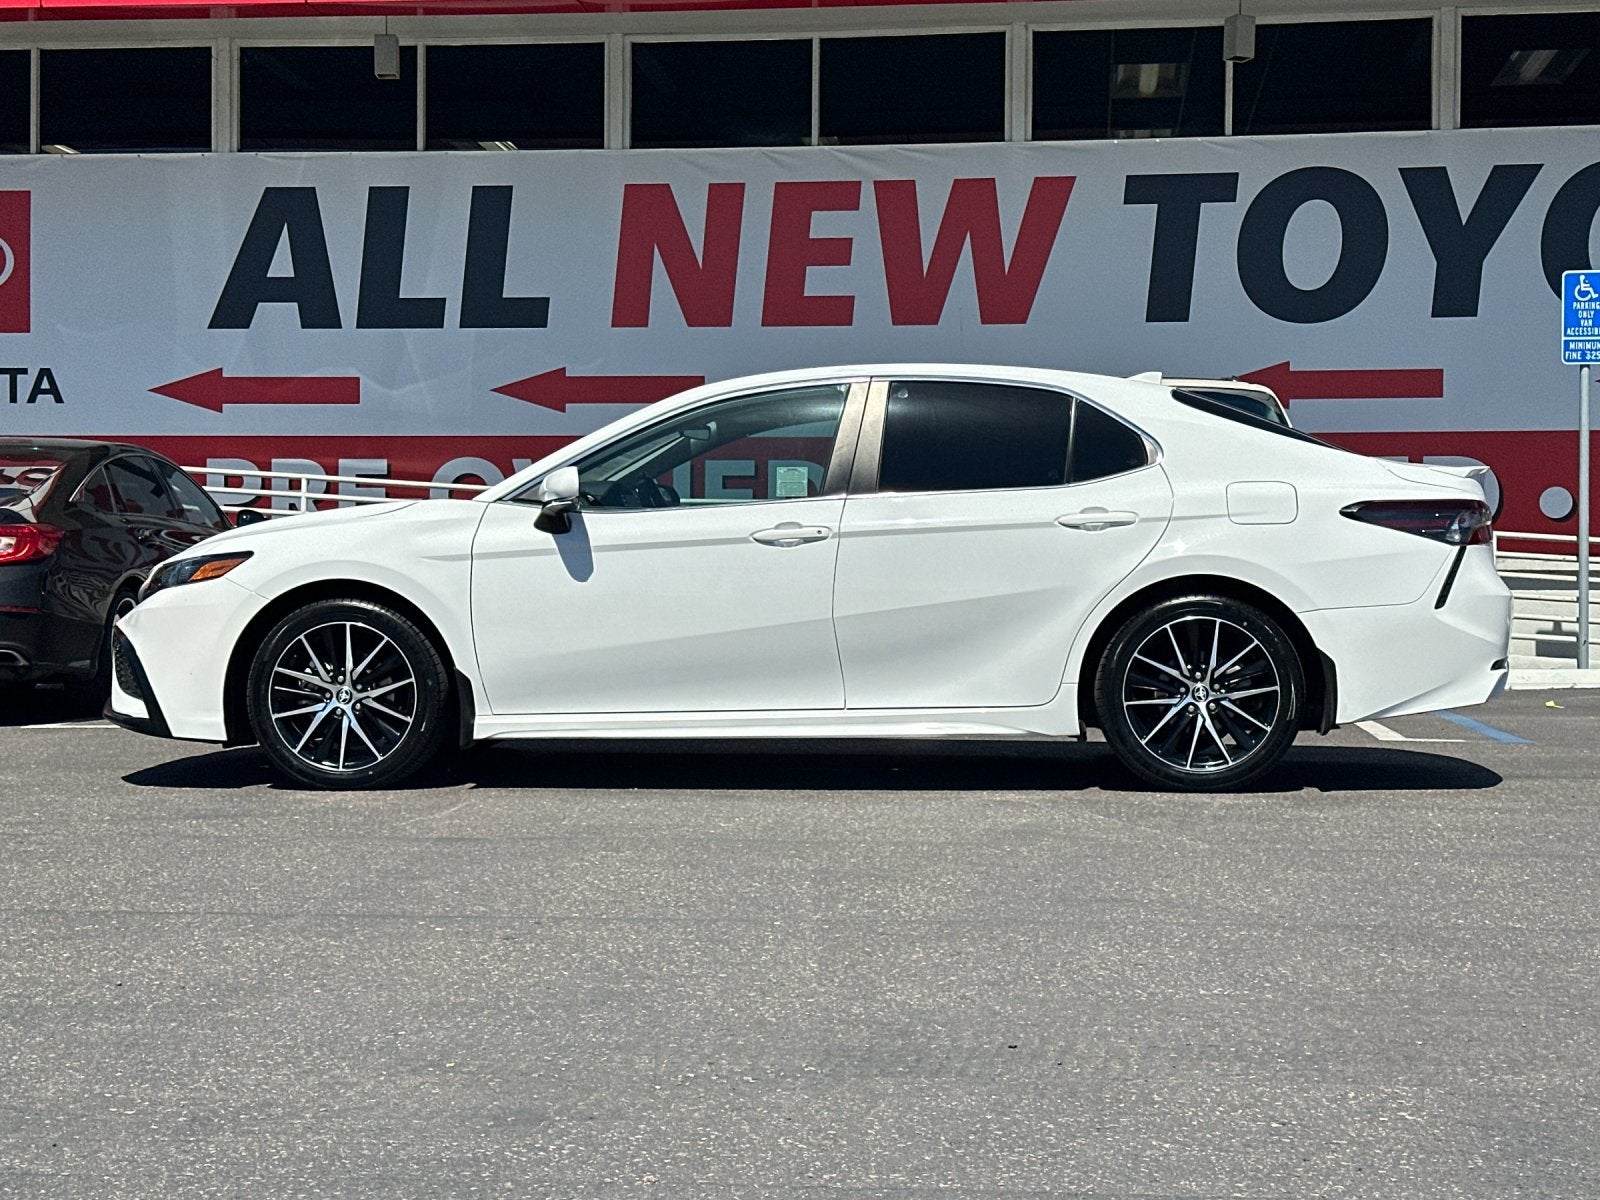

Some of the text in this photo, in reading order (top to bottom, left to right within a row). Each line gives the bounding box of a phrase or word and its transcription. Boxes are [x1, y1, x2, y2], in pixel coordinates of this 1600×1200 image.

[207, 185, 551, 329] ALL
[611, 176, 1077, 327] NEW
[1572, 301, 1600, 310] PARKING
[1578, 310, 1595, 319] ONLY
[1580, 319, 1593, 327] VAN
[1566, 327, 1600, 336] ACCESSIB
[1566, 351, 1582, 360] FINE
